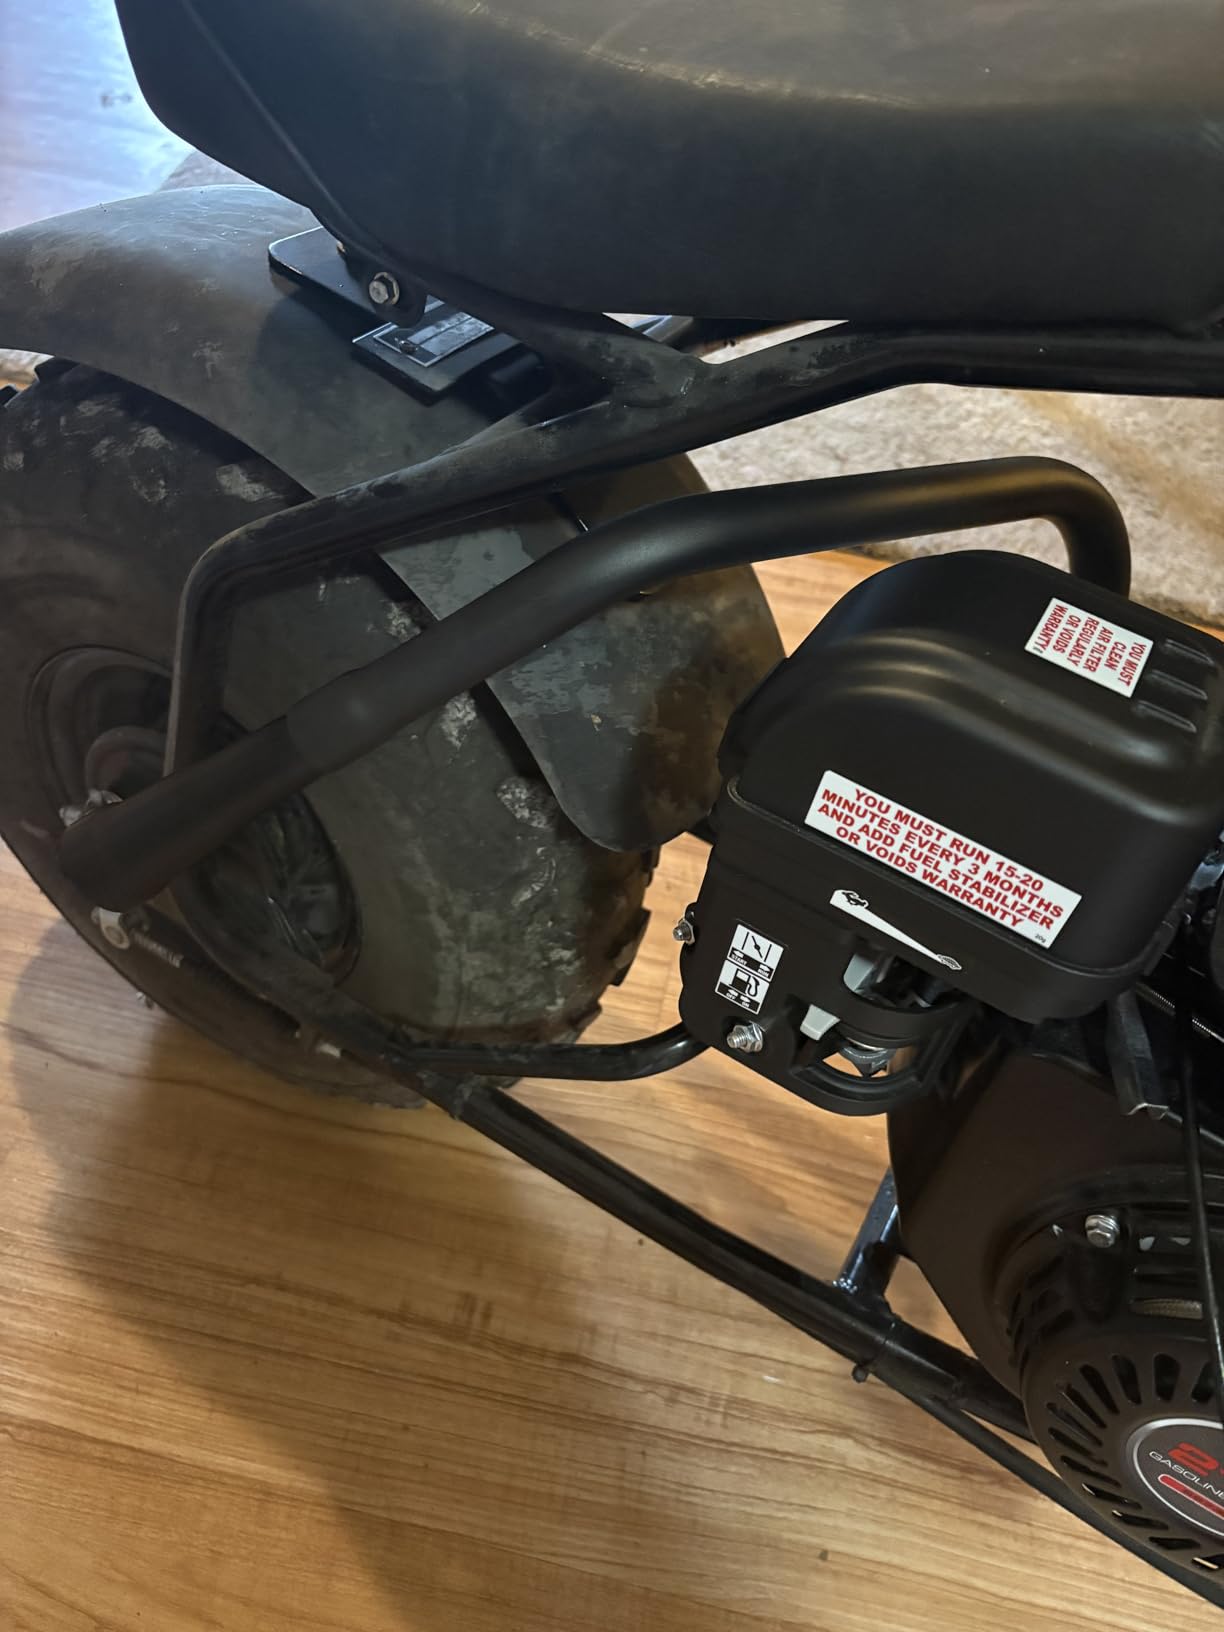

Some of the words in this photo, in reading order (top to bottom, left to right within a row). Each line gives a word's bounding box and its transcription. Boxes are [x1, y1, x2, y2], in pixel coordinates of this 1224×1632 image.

[1035, 604, 1068, 651] WARRANTY
[1066, 615, 1082, 629] OR
[1097, 626, 1114, 644] AIR
[1052, 627, 1076, 654] VOIDS
[1066, 616, 1100, 667] REGULARLY
[1104, 641, 1127, 671] CLEAN
[1128, 642, 1147, 662] YOU
[1083, 641, 1107, 673] FILTER
[1118, 659, 1138, 686] MUST
[822, 789, 901, 835] MINUTES
[904, 830, 966, 866] EVERY
[968, 863, 980, 875] 3
[983, 870, 1064, 918] MONTHS
[855, 788, 891, 815] YOU
[894, 810, 947, 842] MUST
[949, 837, 990, 865] RUN
[995, 861, 1044, 891] 15-20
[818, 803, 855, 827] AND
[858, 823, 895, 848] ADD
[899, 842, 943, 873] FUEL
[948, 868, 1054, 930] STABILIZER
[836, 826, 861, 846] OR
[866, 840, 918, 874] VOIDS
[921, 869, 1024, 927] WARRANTY
[731, 953, 747, 966] START
[1167, 1442, 1224, 1477] 2
